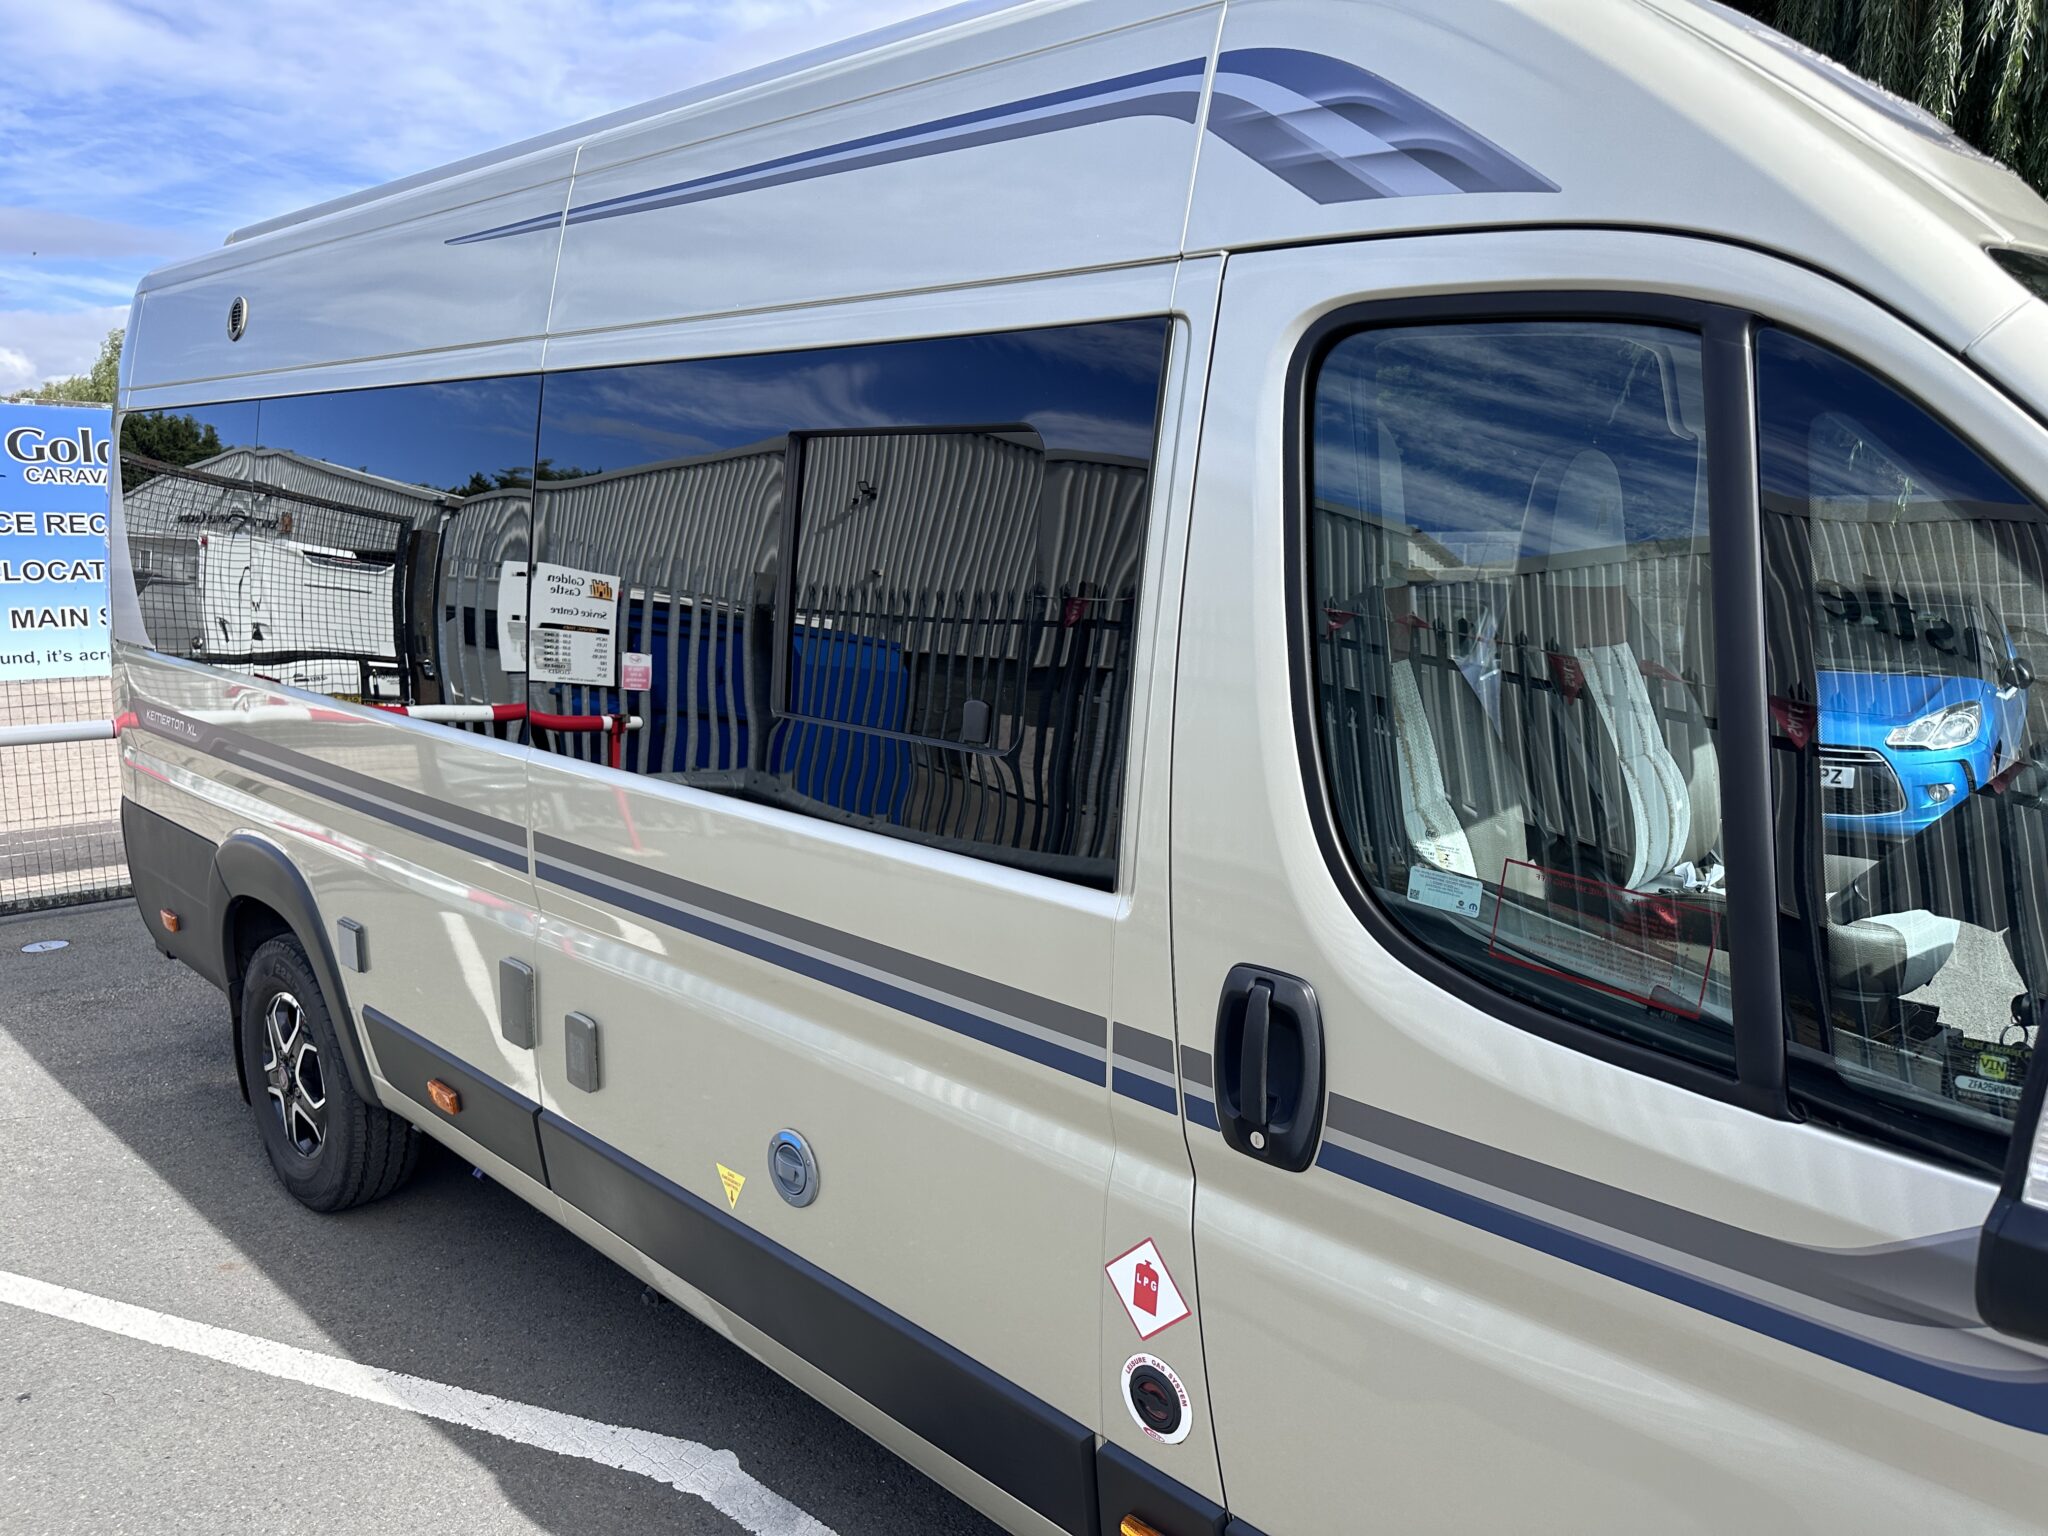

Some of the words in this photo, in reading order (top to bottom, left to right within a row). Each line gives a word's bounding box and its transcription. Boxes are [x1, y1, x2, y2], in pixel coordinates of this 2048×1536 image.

[11, 608, 88, 629] MAIN
[47, 650, 73, 662] it's
[79, 651, 110, 661] acr
[146, 709, 185, 732] KEMERTON
[186, 723, 198, 737] XL
[1981, 1057, 2006, 1072] VIN
[1136, 1272, 1158, 1292] LPG
[1125, 1356, 1147, 1375] LEISURE
[1151, 1359, 1166, 1372] GAS
[1168, 1372, 1188, 1408] SYSTEM
